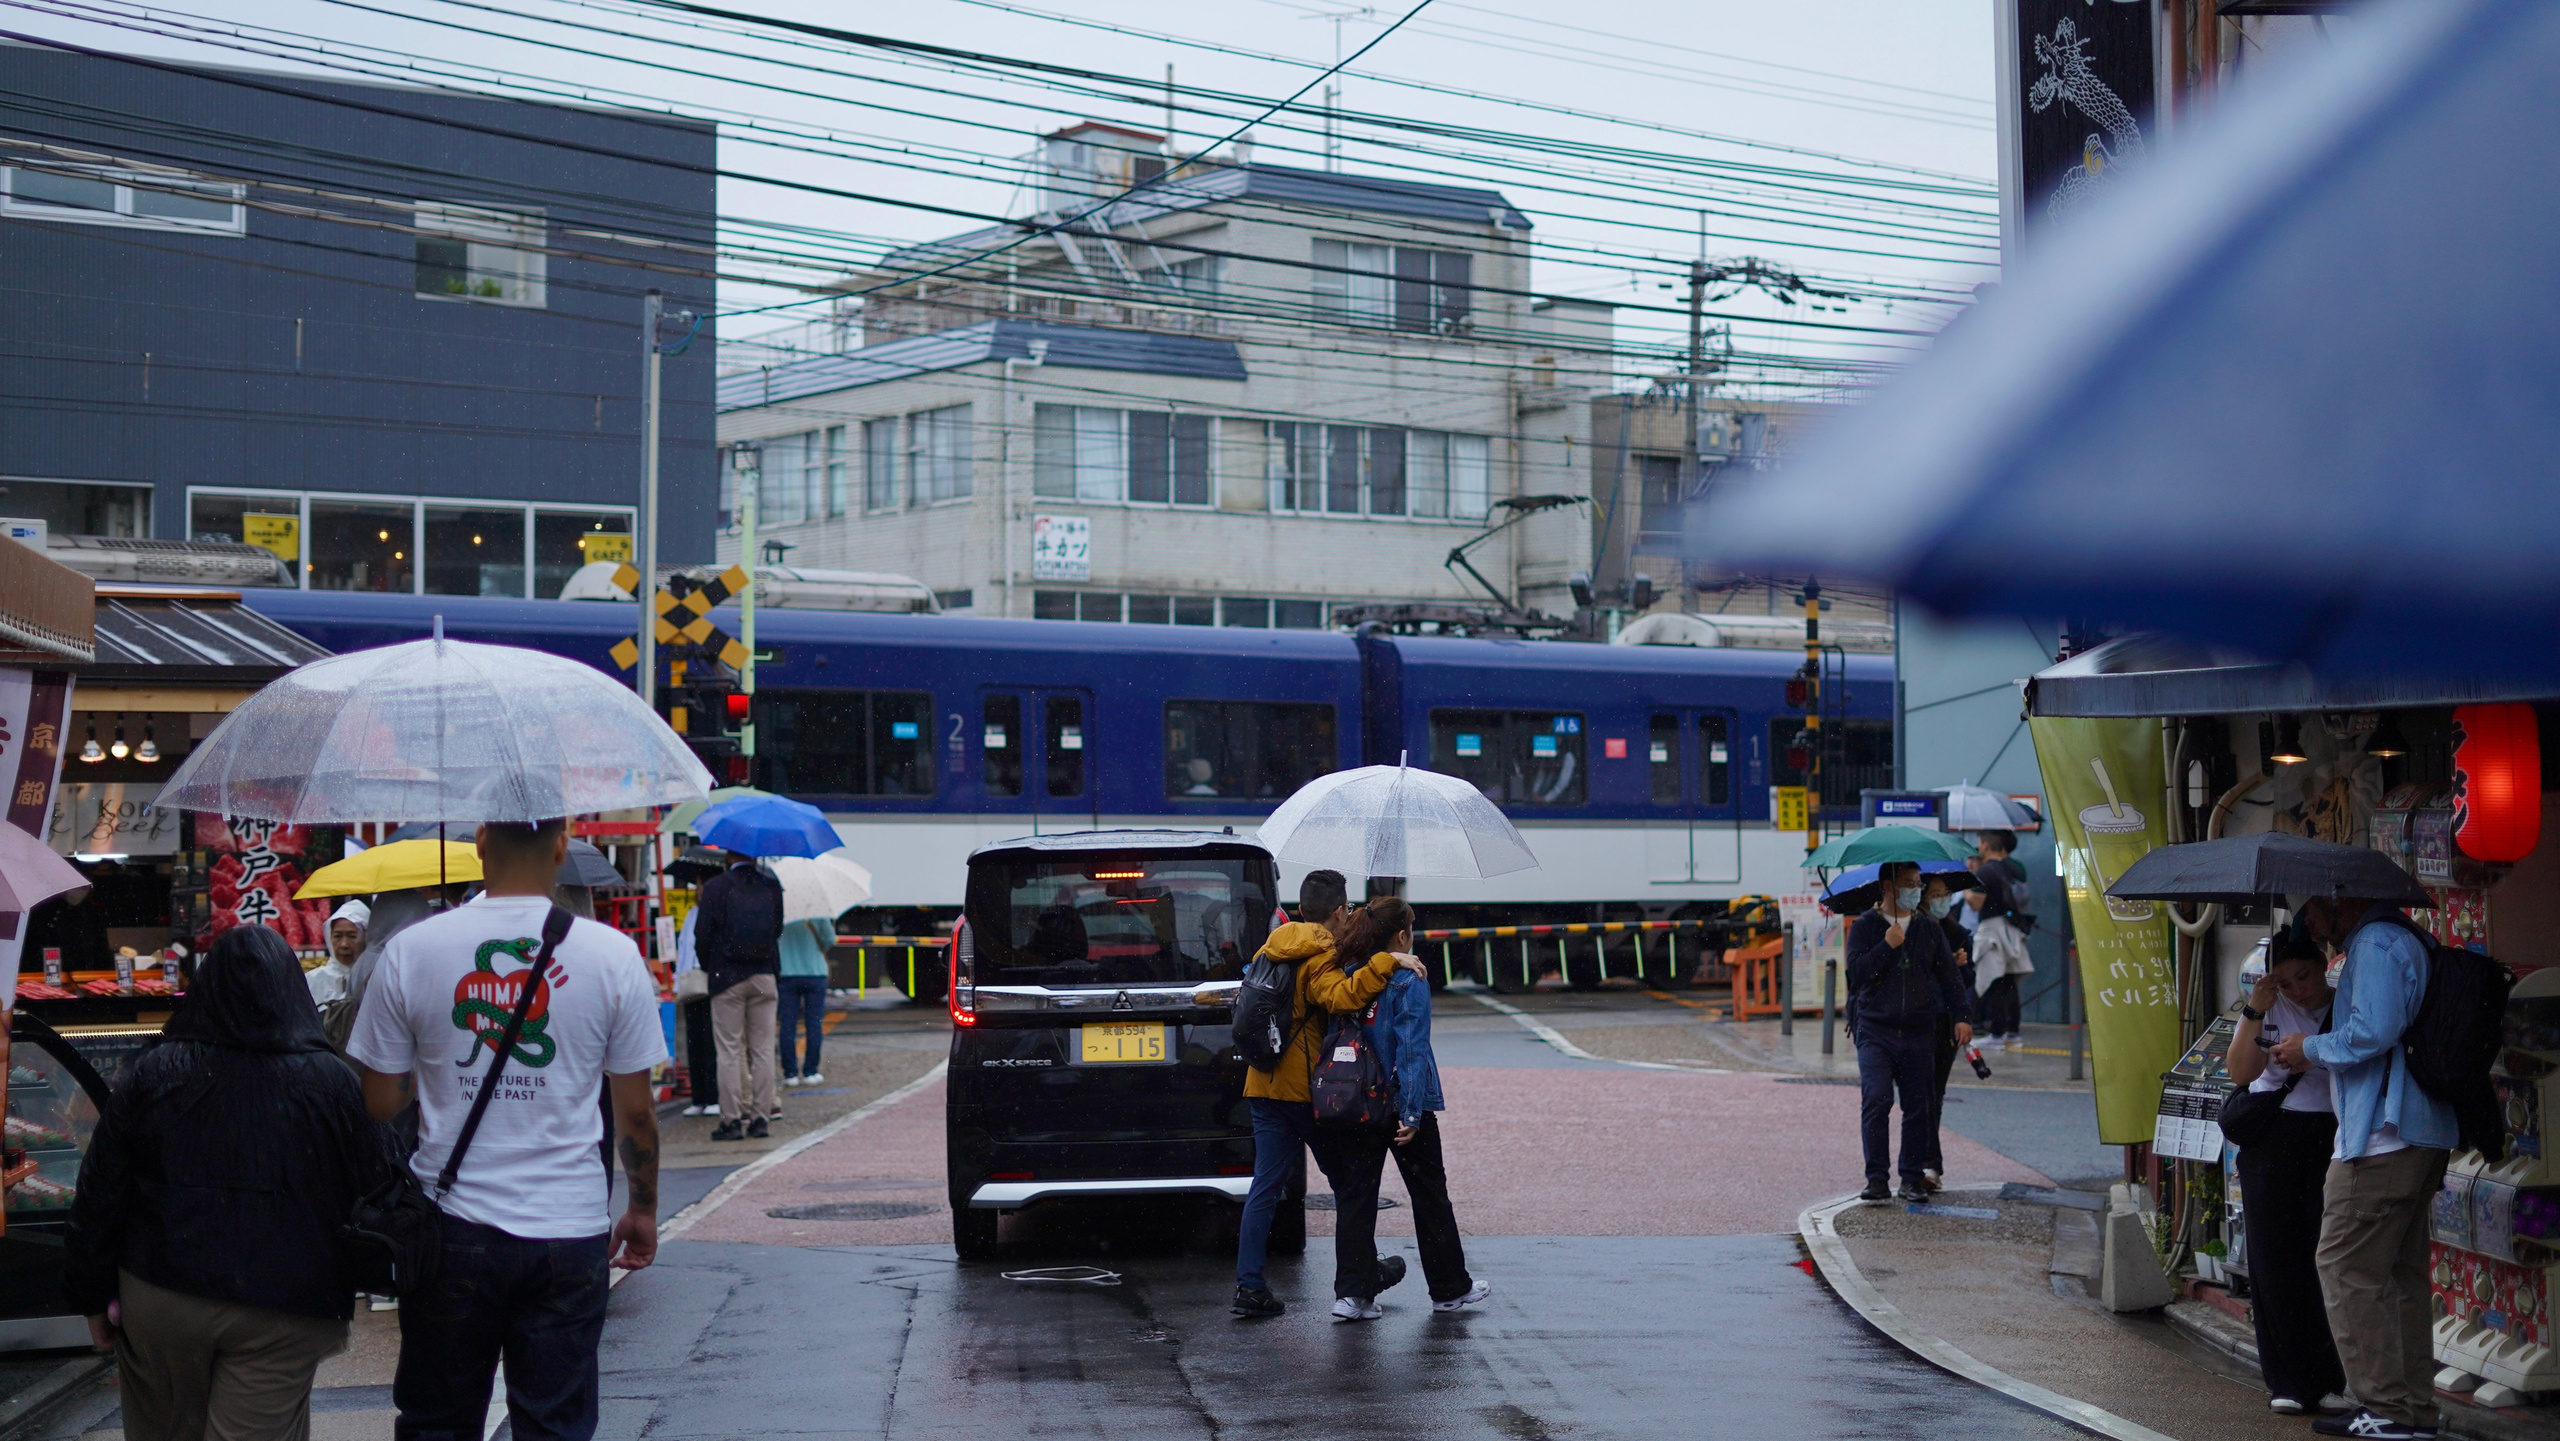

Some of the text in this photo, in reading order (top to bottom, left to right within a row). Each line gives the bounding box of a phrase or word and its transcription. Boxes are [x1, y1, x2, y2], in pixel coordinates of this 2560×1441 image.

[948, 713, 965, 742] 2
[1750, 734, 1759, 759] 1
[16, 722, 55, 806] 京都
[467, 982, 537, 1005] HUMA
[458, 1076, 479, 1087] THE
[535, 1076, 546, 1087] IS
[461, 1091, 474, 1101] IN
[505, 1089, 537, 1101] PAST
